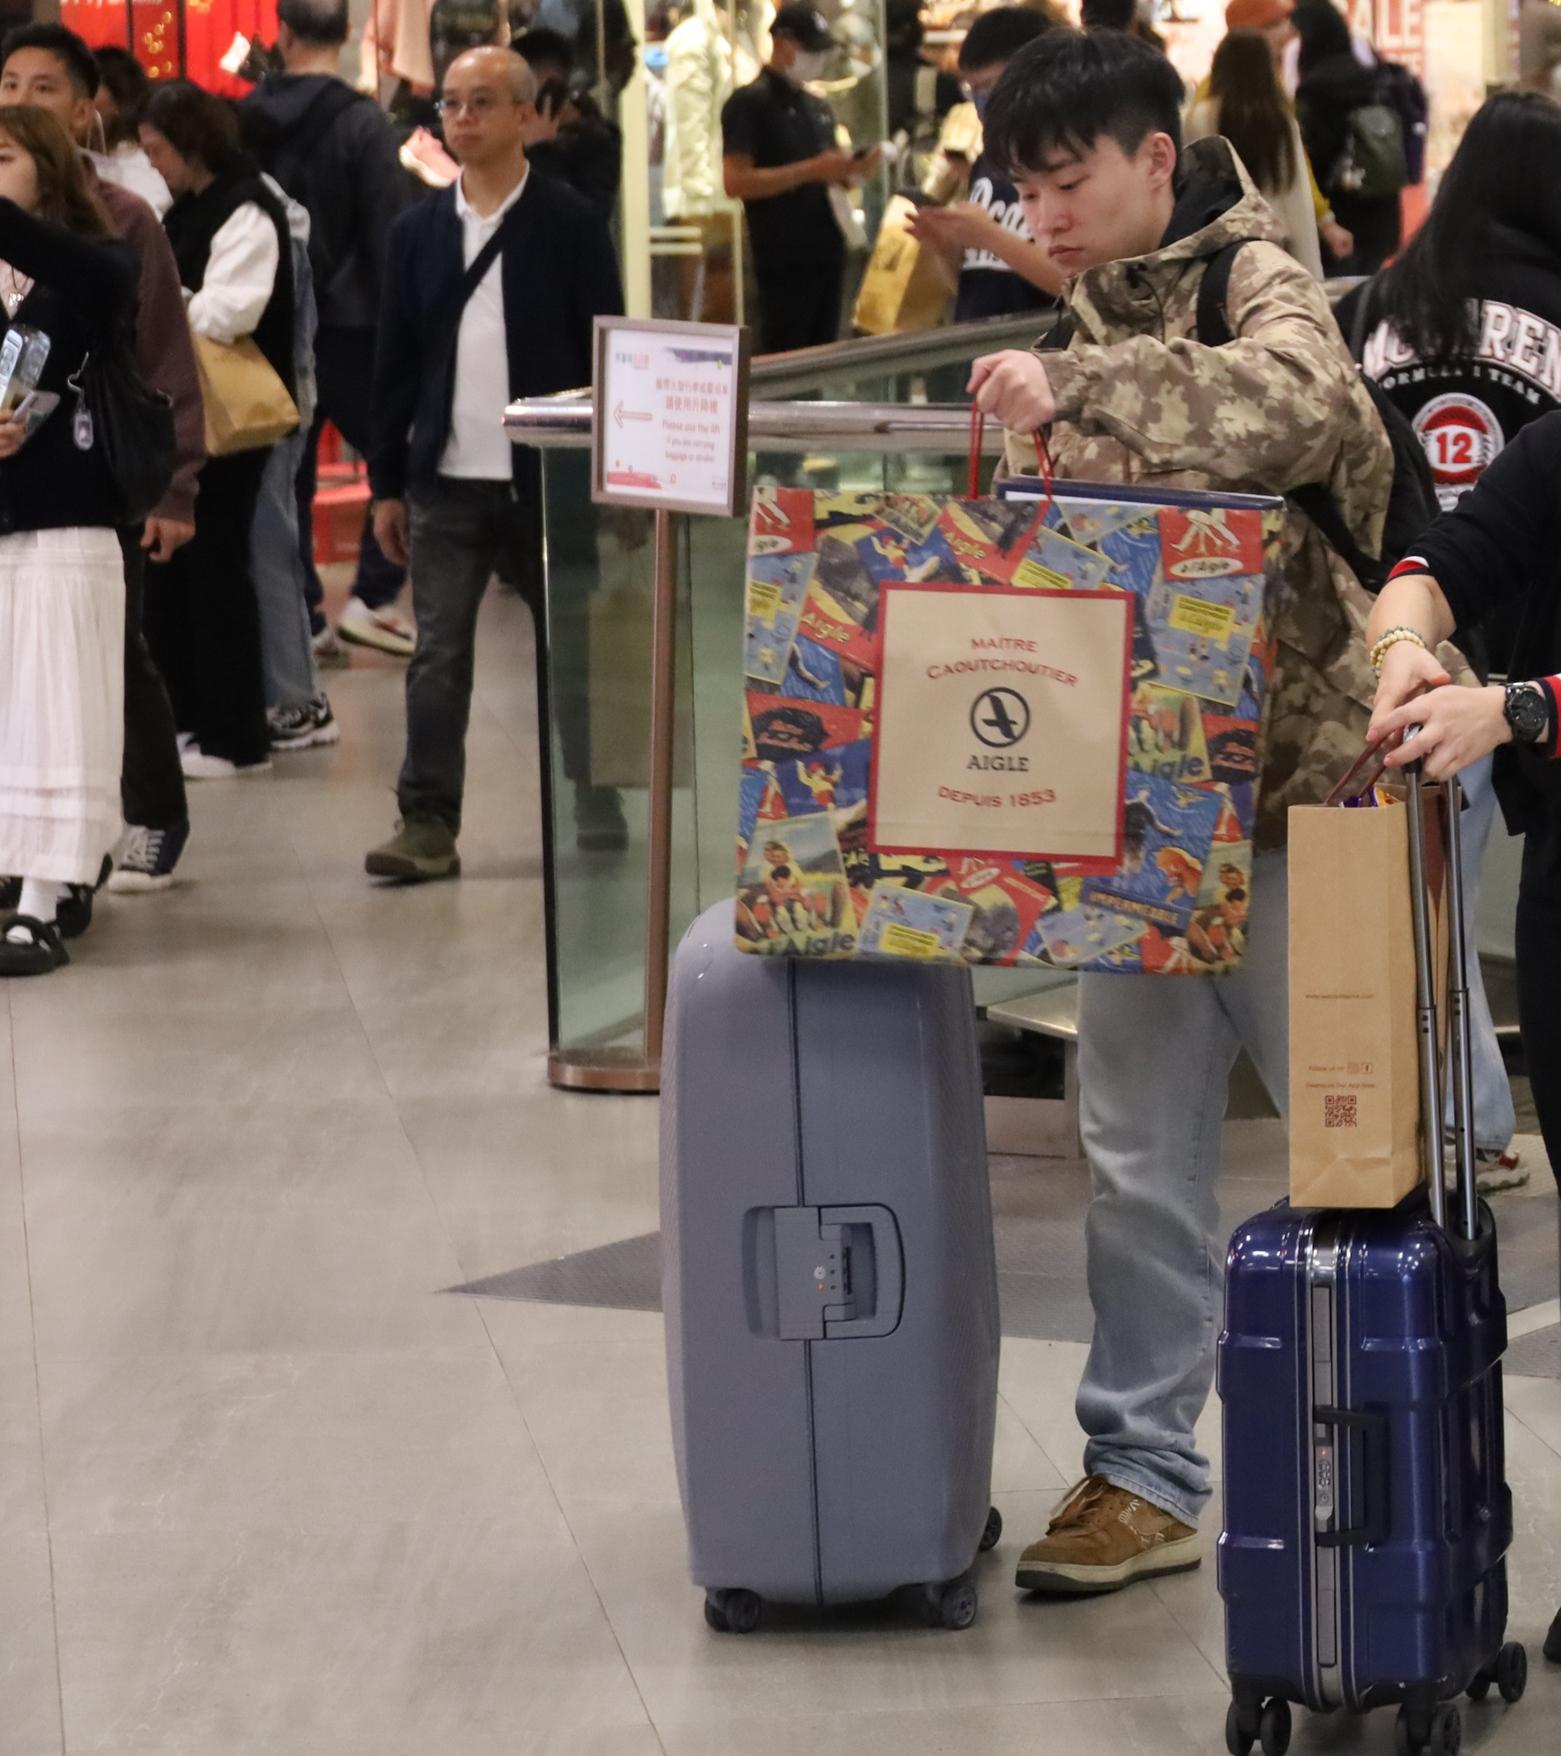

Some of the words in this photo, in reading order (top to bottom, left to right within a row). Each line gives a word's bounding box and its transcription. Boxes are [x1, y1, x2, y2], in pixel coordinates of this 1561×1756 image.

[1488, 367, 1541, 404] TEAM
[1436, 432, 1473, 464] 12
[926, 658, 1079, 687] CAOUTCHOUTIER
[967, 755, 1030, 772] AIGLE
[937, 785, 1003, 808] DEPUIS
[1009, 788, 1057, 808] 1853
